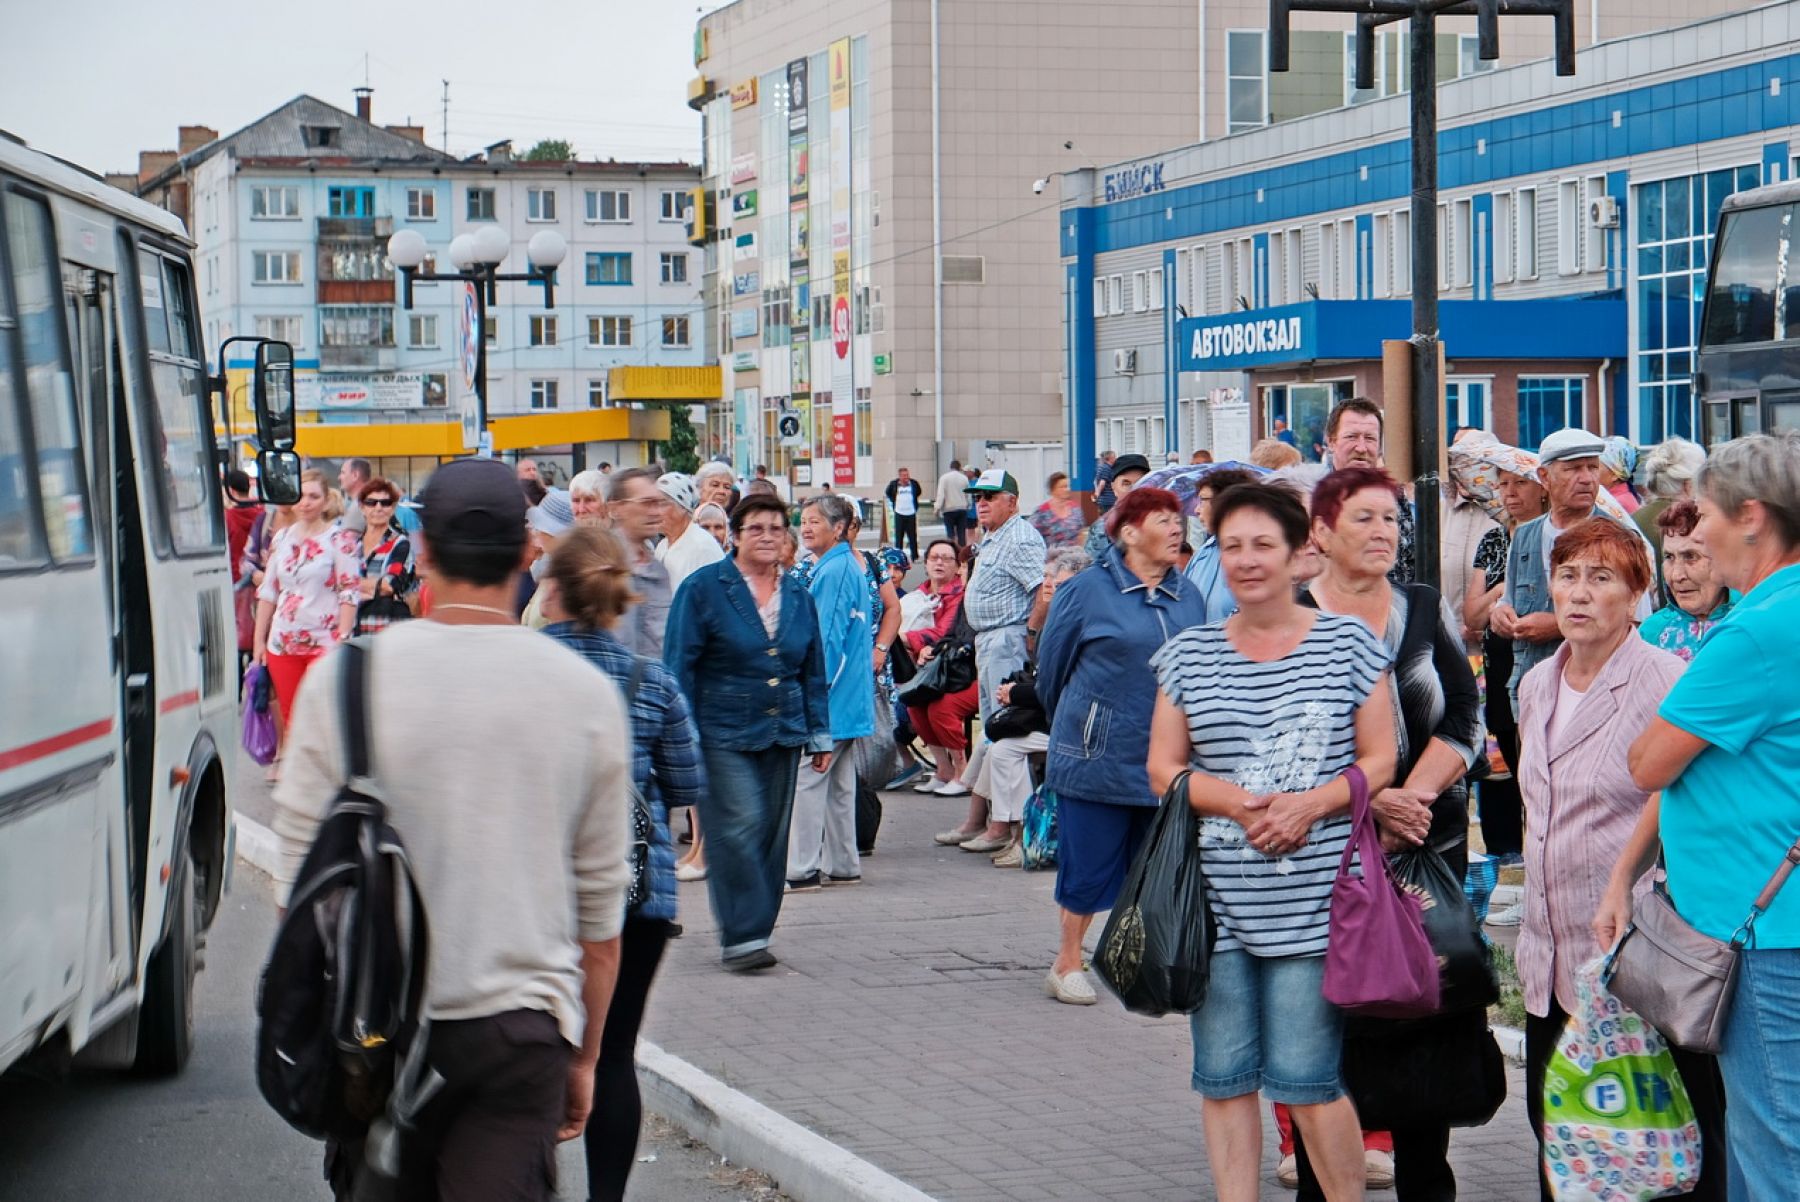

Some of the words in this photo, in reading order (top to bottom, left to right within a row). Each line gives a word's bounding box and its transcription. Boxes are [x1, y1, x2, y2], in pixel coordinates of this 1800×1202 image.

[1105, 161, 1166, 202] БИЙСК
[1192, 317, 1301, 359] АВТОВОКЗАЛ
[1595, 1084, 1617, 1110] F
